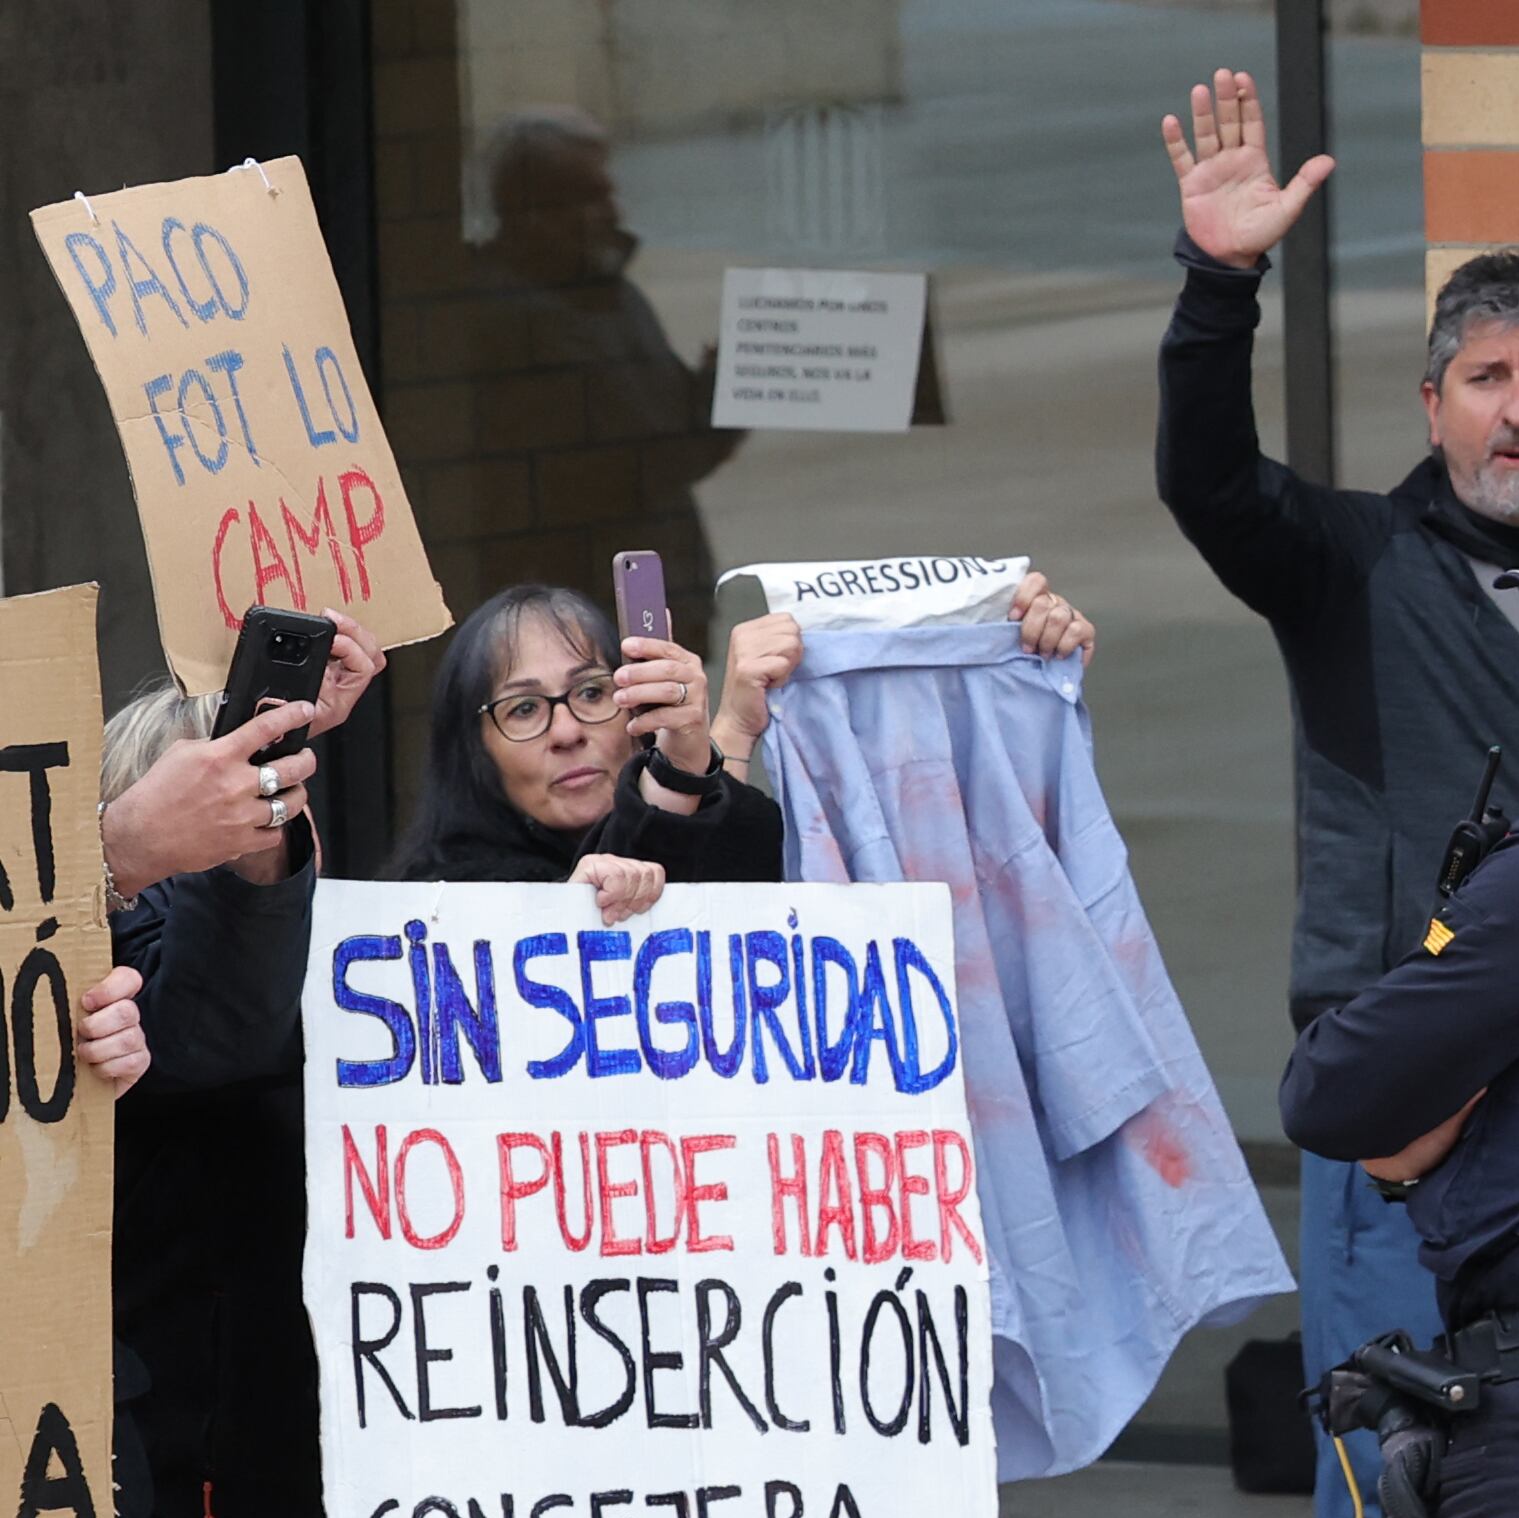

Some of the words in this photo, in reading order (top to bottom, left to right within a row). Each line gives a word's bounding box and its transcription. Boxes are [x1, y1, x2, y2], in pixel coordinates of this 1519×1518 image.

[64, 216, 250, 338] PACO
[142, 350, 260, 486] FOT
[281, 341, 360, 448] LO
[213, 463, 386, 632] CAMP
[0, 741, 69, 911] T
[0, 916, 75, 1124] Ó
[333, 918, 504, 1089] SIN
[513, 906, 960, 1096] SEGURIDAD
[341, 1122, 465, 1253] NO
[498, 1127, 737, 1258] PUEDE
[767, 1127, 983, 1265] HABER
[350, 1264, 971, 1447] REINSERCIÓN
